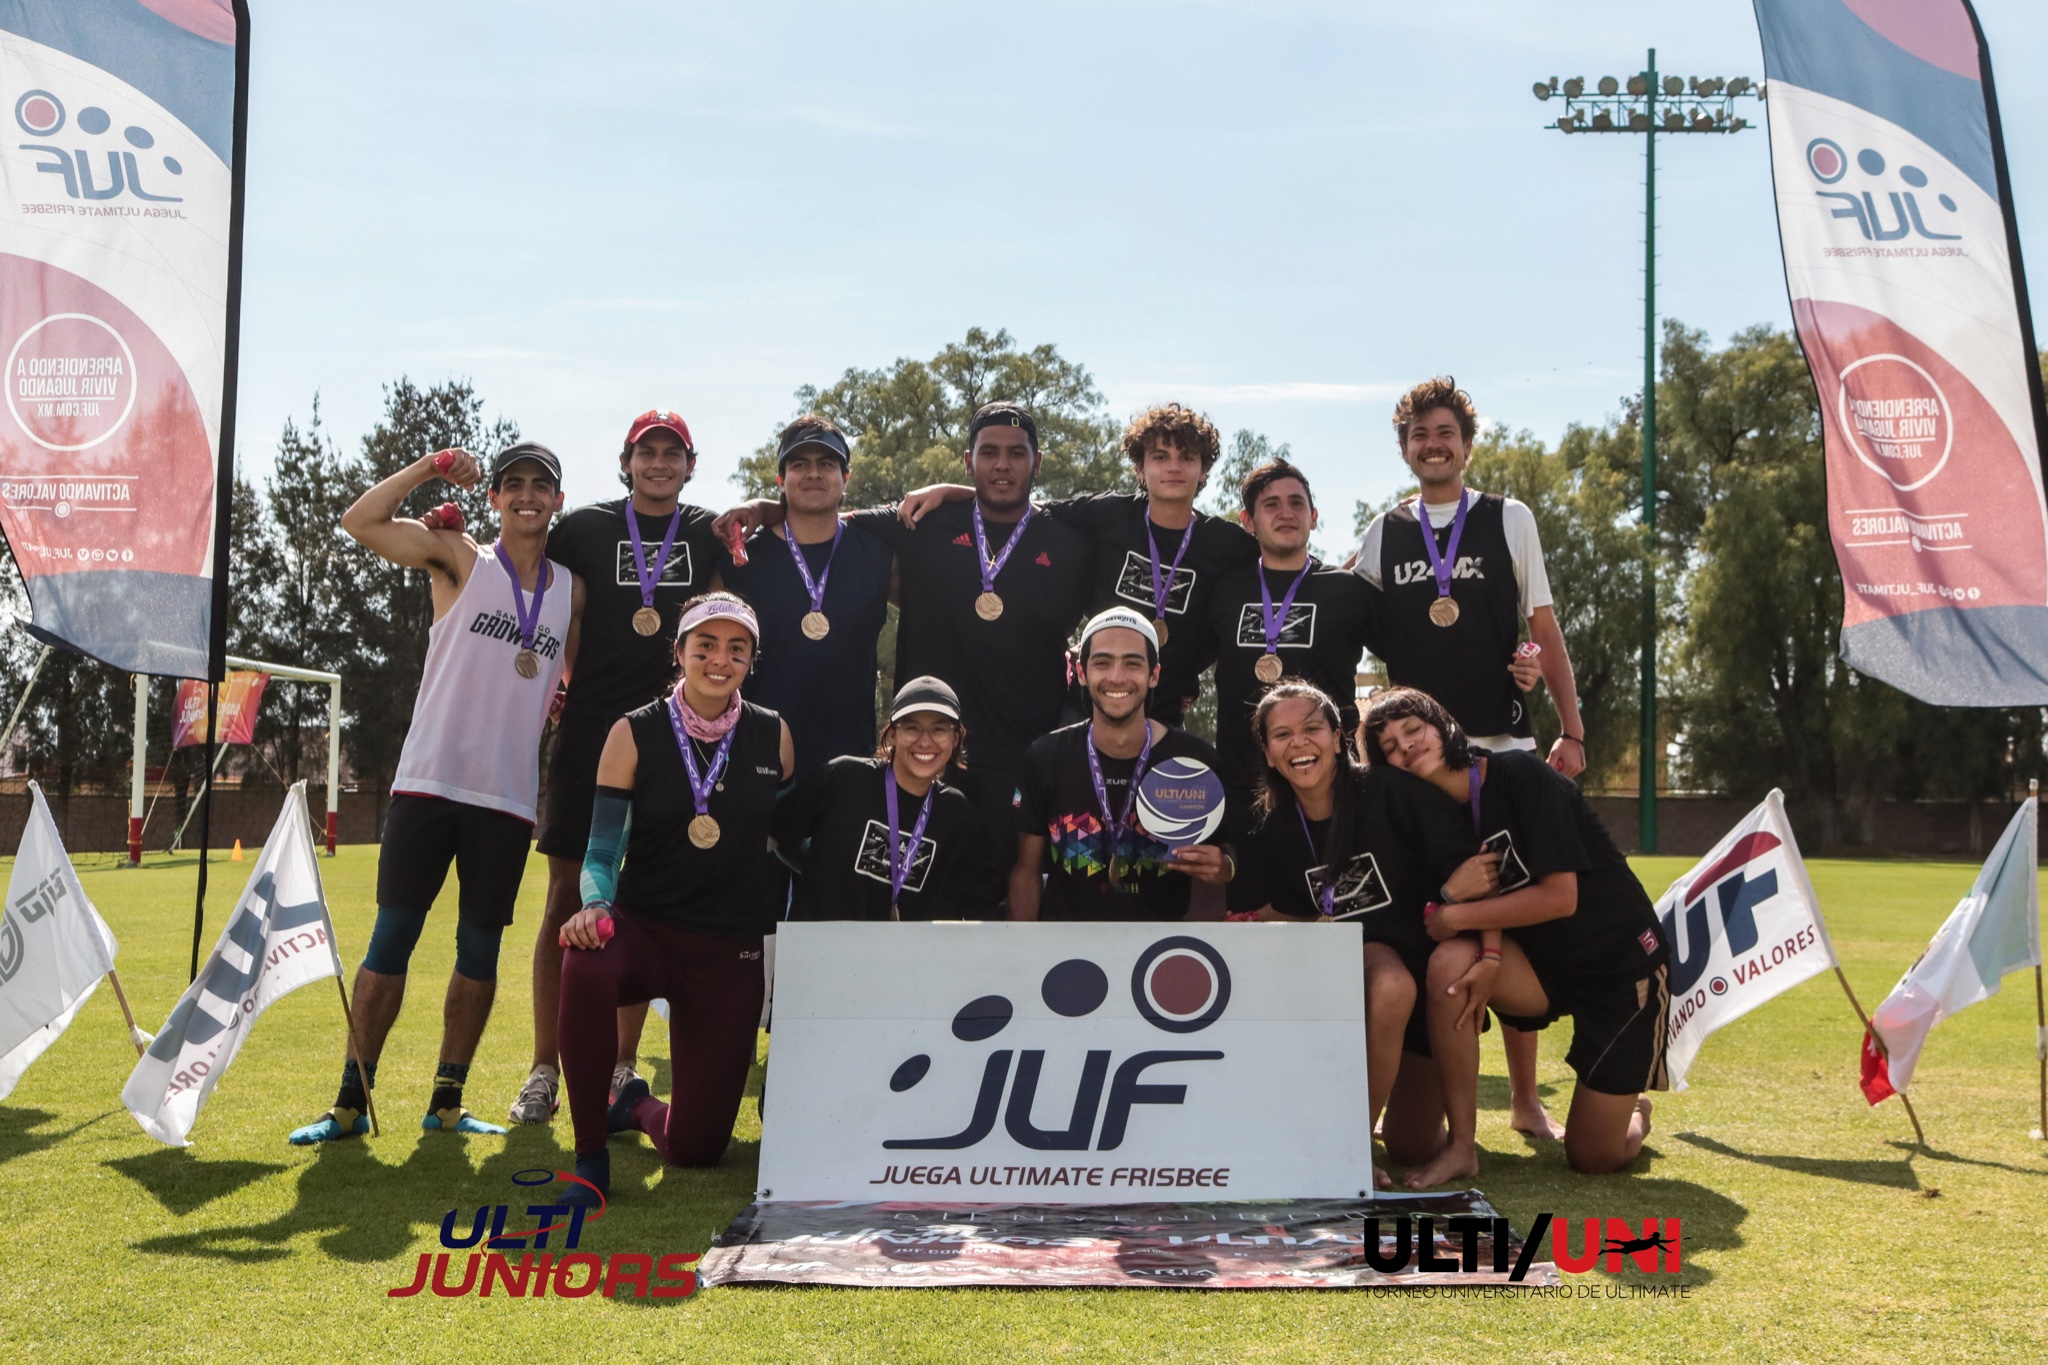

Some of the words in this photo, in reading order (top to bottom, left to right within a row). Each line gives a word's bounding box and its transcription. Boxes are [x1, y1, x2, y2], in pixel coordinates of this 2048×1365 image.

[469, 612, 561, 661] GROWERS
[495, 609, 517, 622] SAN
[1732, 923, 1816, 987] VALORES
[881, 1048, 1226, 1152] JUF
[869, 1165, 962, 1186] JUEGA
[969, 1165, 1103, 1187] ULTIMATE
[1109, 1166, 1230, 1188] FRISBEE
